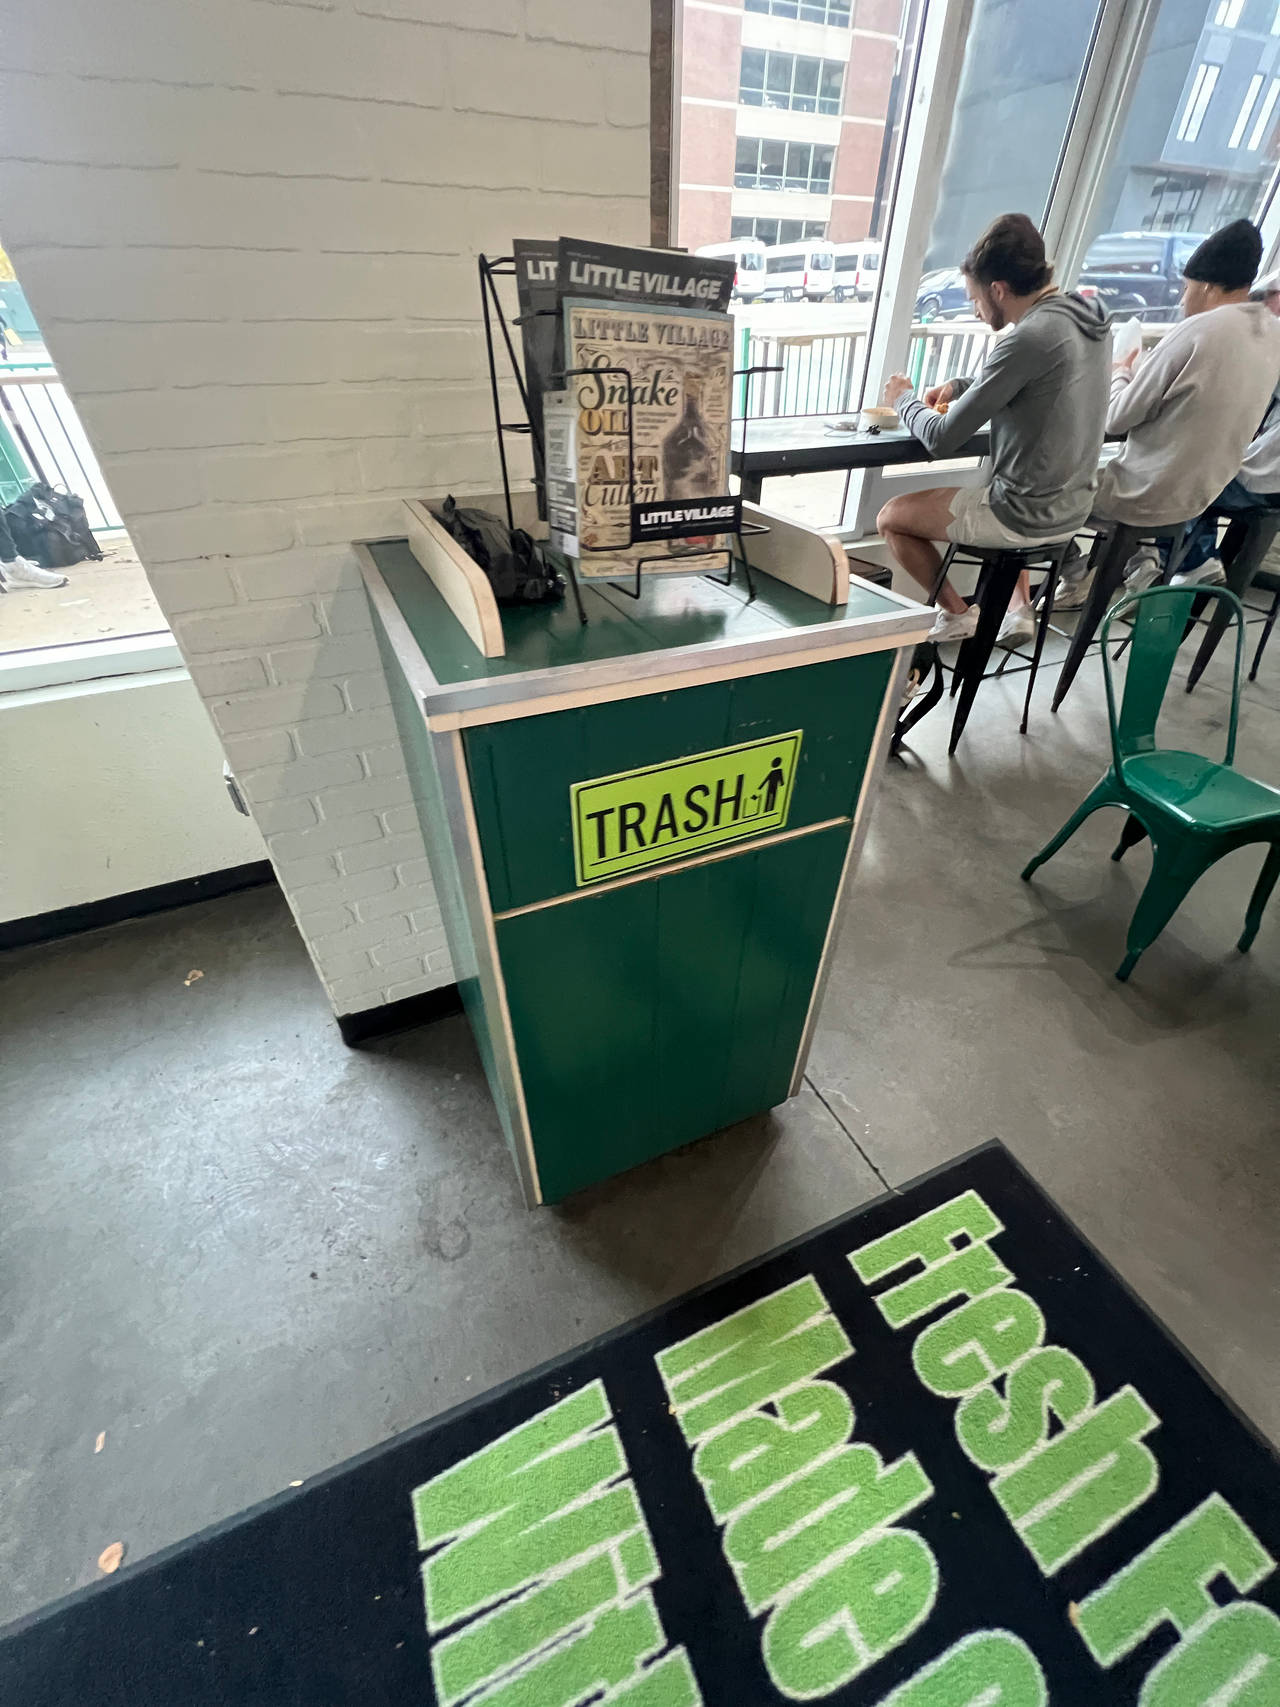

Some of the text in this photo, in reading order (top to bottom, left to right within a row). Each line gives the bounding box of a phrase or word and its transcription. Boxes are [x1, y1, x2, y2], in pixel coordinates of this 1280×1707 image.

[573, 316, 729, 348] LITTLE VILLAGE
[578, 354, 679, 410] Snake
[578, 409, 630, 436] OIL
[585, 774, 745, 859] TRASH
[846, 1189, 1161, 1578] Fresh
[654, 1274, 940, 1701] Made
